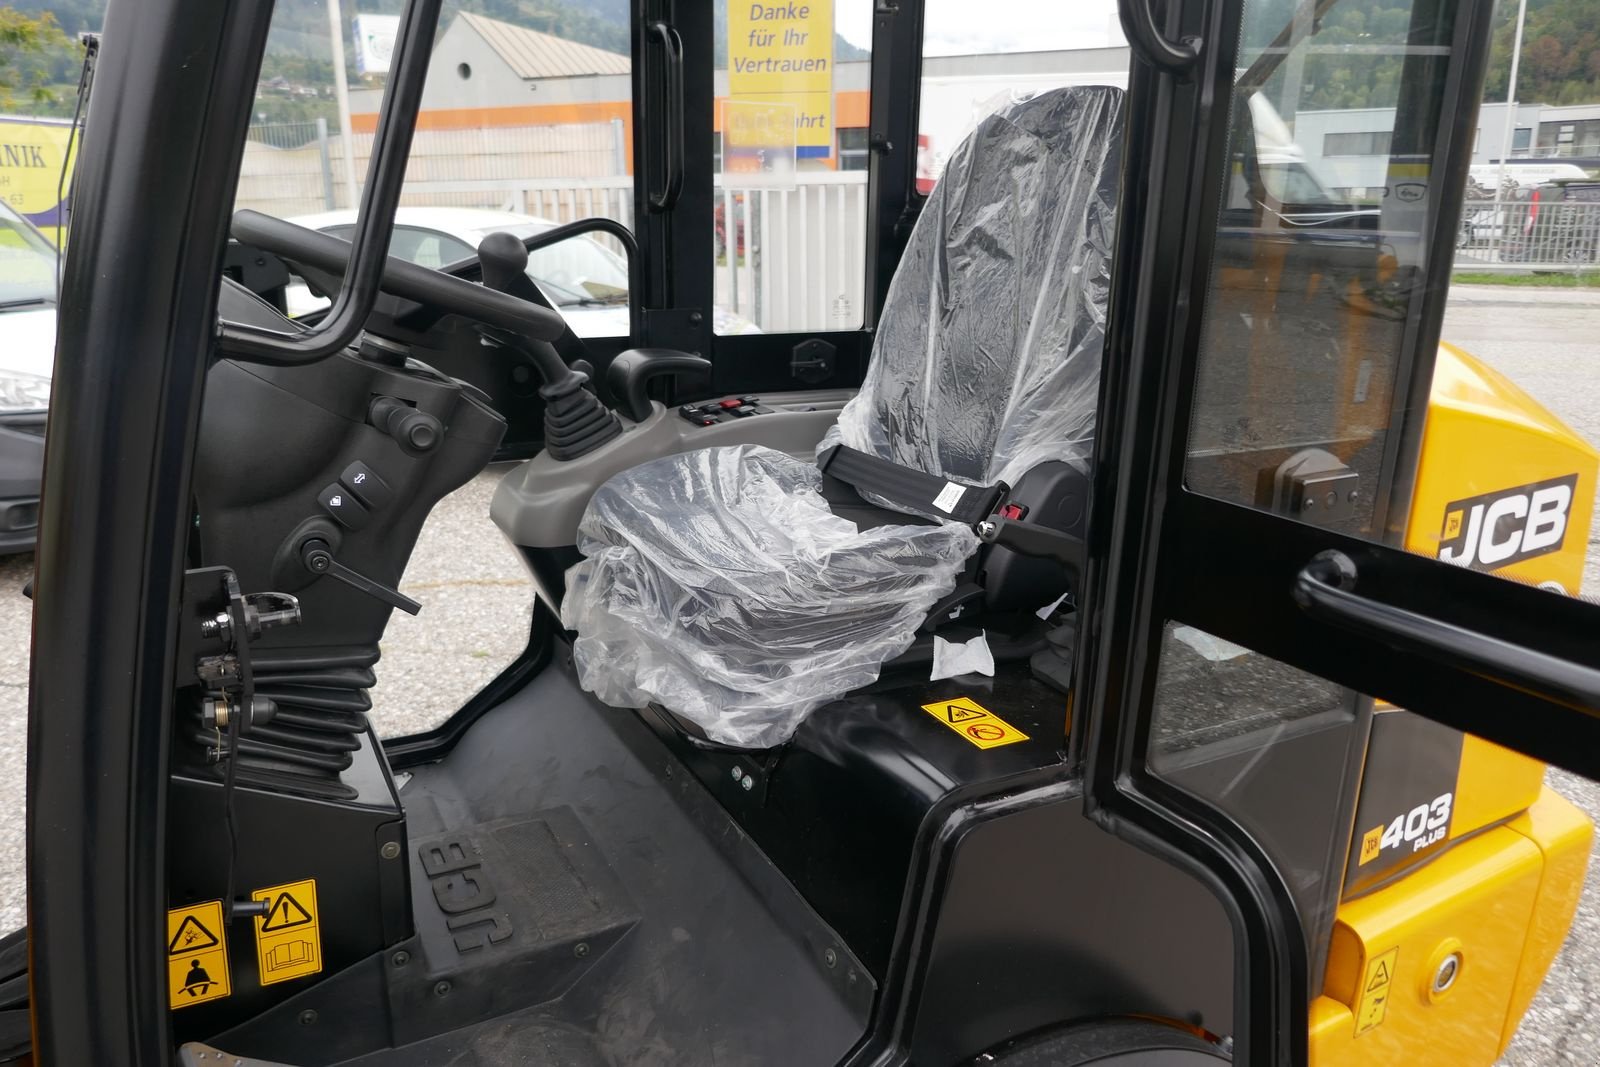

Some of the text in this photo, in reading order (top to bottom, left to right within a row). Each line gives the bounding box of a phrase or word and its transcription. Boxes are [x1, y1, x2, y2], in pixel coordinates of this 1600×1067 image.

[750, 2, 809, 21] Danke
[748, 28, 808, 47] für Ihr
[734, 57, 827, 74] Vertrauen
[0, 144, 47, 168] NIK
[1440, 484, 1571, 568] JCB
[1380, 792, 1452, 849] 403
[1413, 826, 1446, 852] PLUS
[418, 833, 513, 954] JCB
